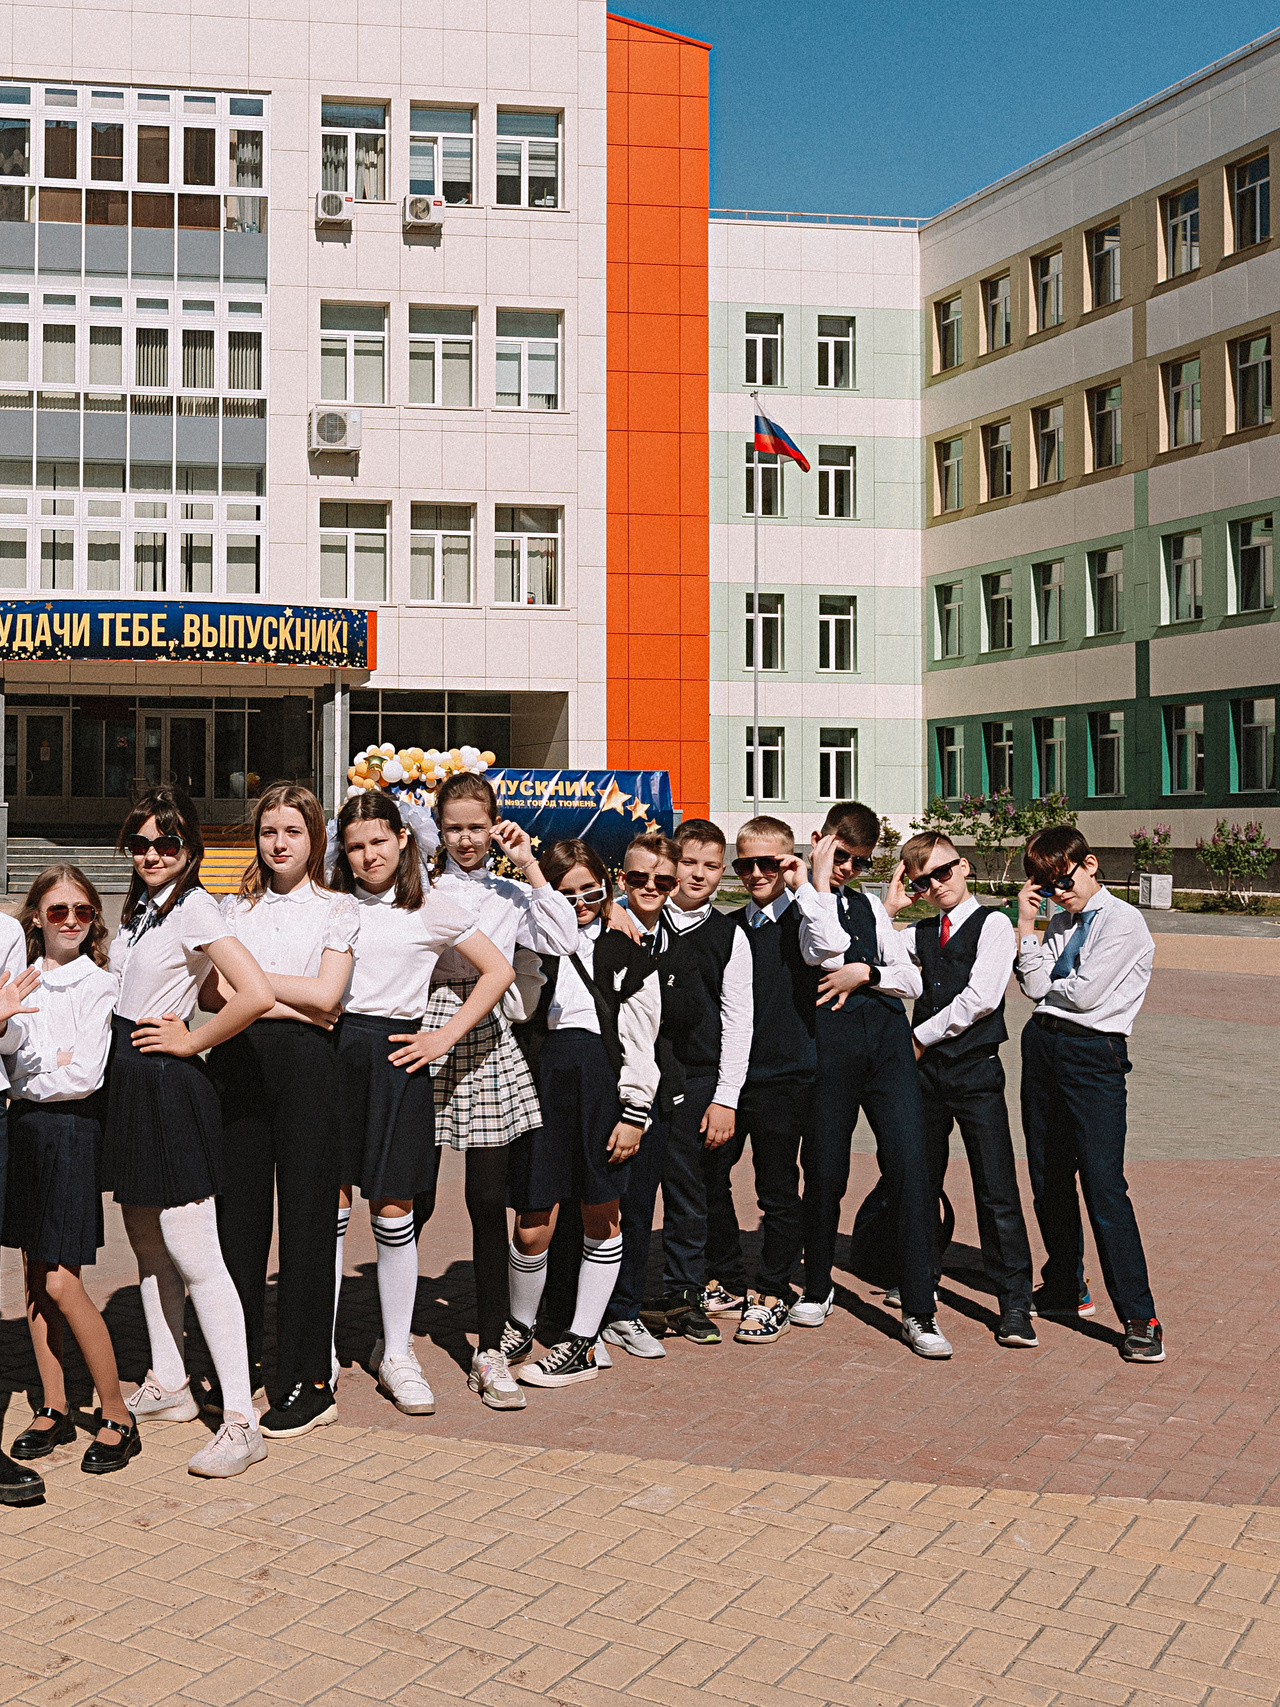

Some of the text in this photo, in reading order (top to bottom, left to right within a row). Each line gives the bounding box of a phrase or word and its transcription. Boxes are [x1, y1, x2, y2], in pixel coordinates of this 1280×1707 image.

[98, 613, 175, 651] ТЕБЕ,
[184, 613, 349, 655] ВЫПУСКНИК!
[490, 780, 596, 796] ПУСКНИК
[558, 800, 597, 808] ТЮМЕНЬ
